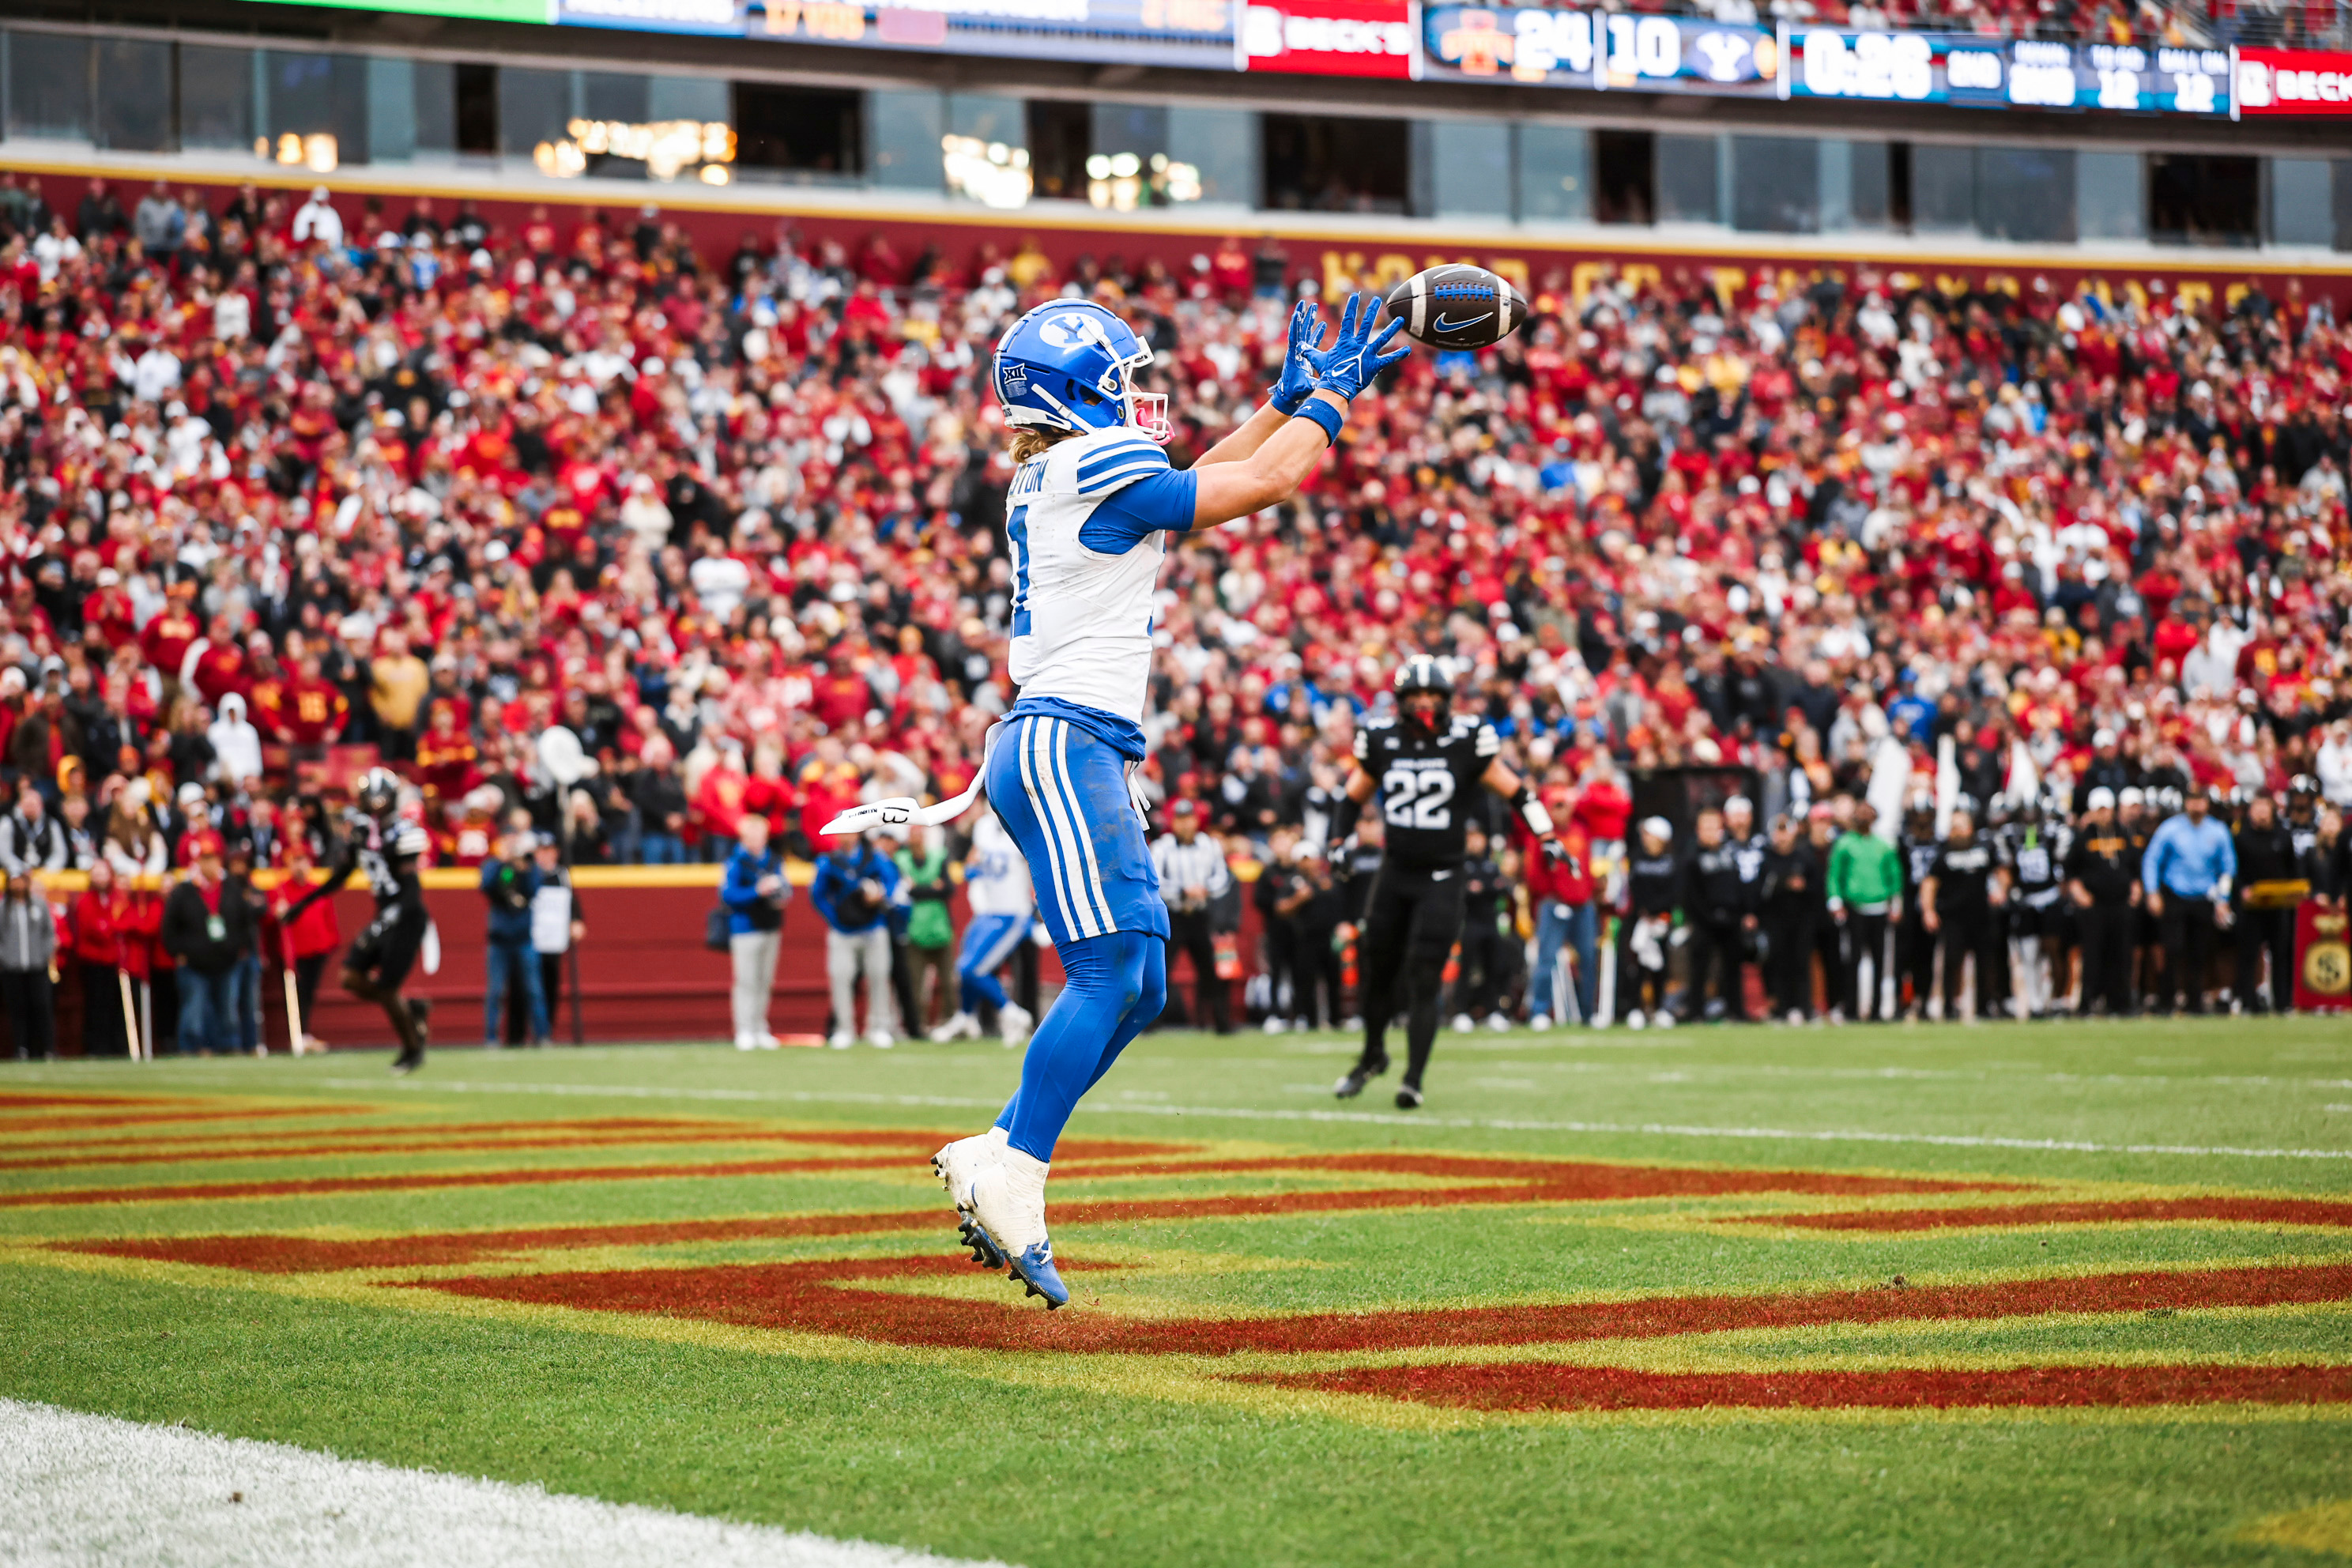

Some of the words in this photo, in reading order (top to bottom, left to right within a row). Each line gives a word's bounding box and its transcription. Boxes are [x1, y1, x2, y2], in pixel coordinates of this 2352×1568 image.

[1515, 9, 1592, 71] 24
[1607, 14, 1680, 77] 10
[1046, 315, 1085, 345] Y
[1383, 769, 1455, 830] 22
